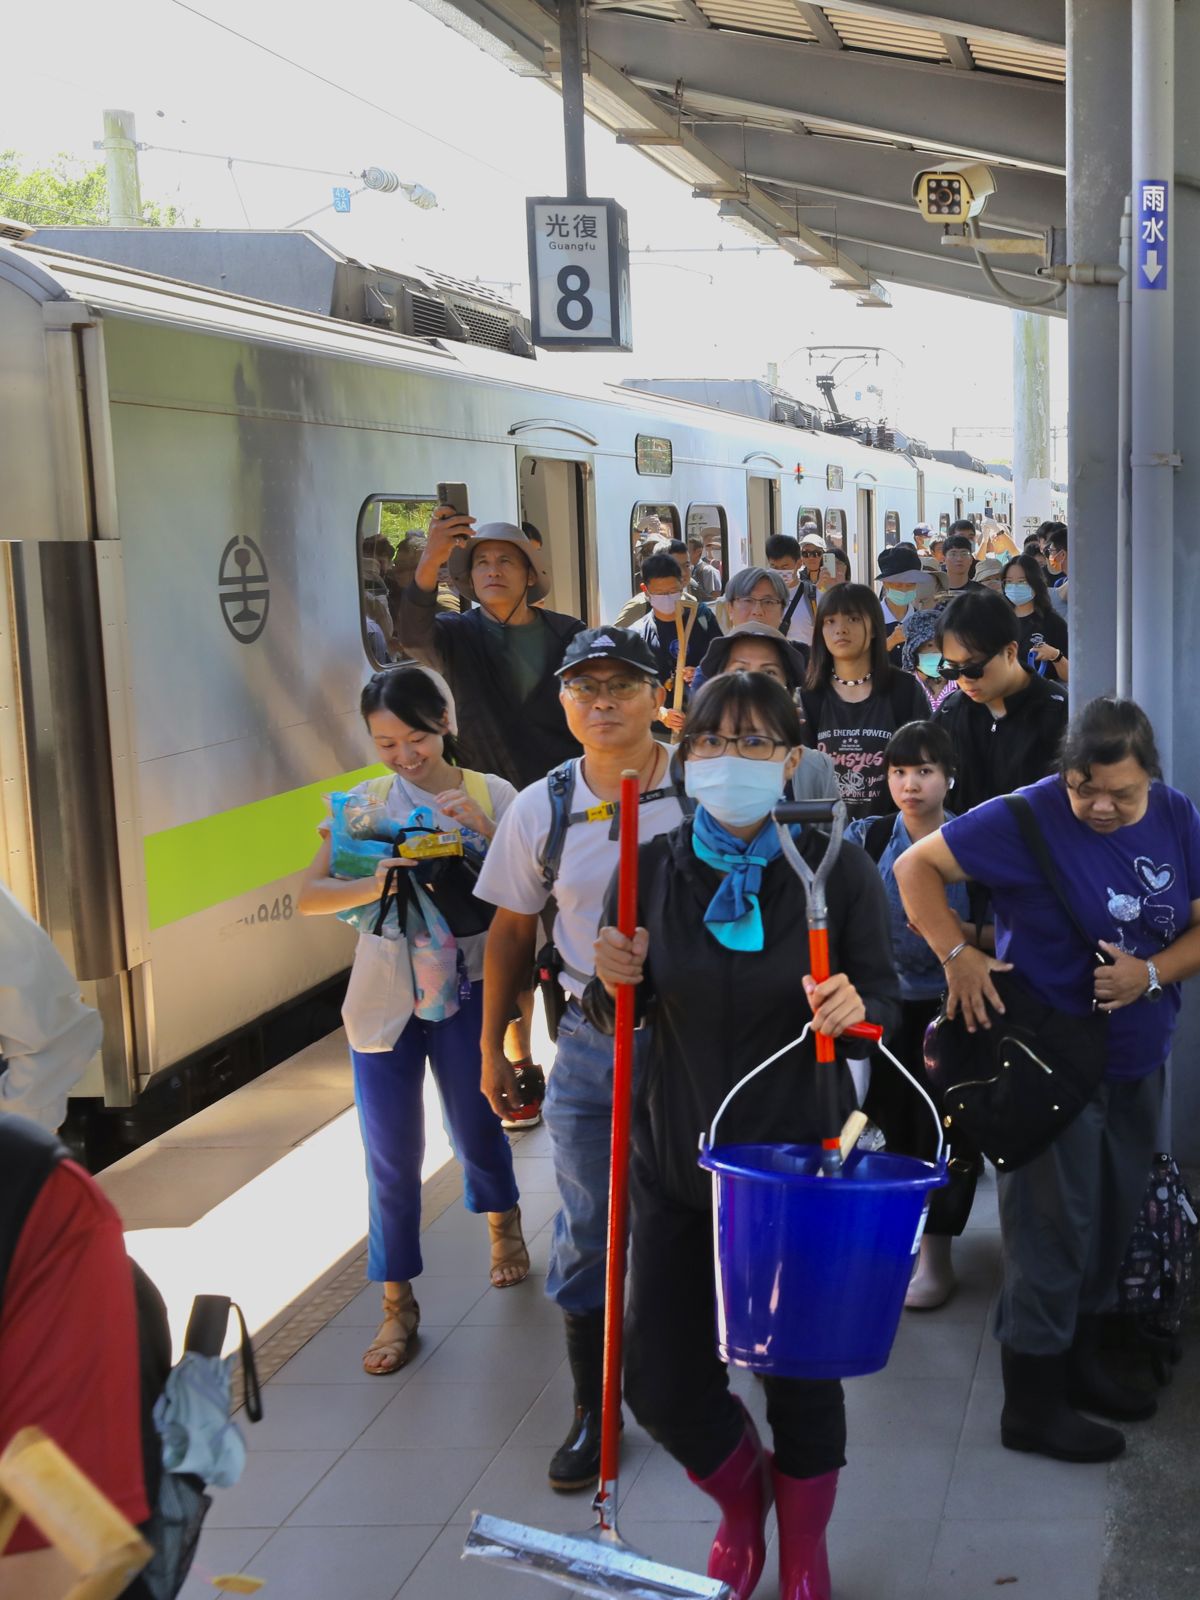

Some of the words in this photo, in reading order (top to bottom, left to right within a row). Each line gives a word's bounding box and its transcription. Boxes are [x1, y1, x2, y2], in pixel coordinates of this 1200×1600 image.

[545, 213, 598, 239] 光復
[1142, 185, 1165, 244] 雨水
[549, 241, 596, 252] Guangfu
[556, 264, 594, 331] 8
